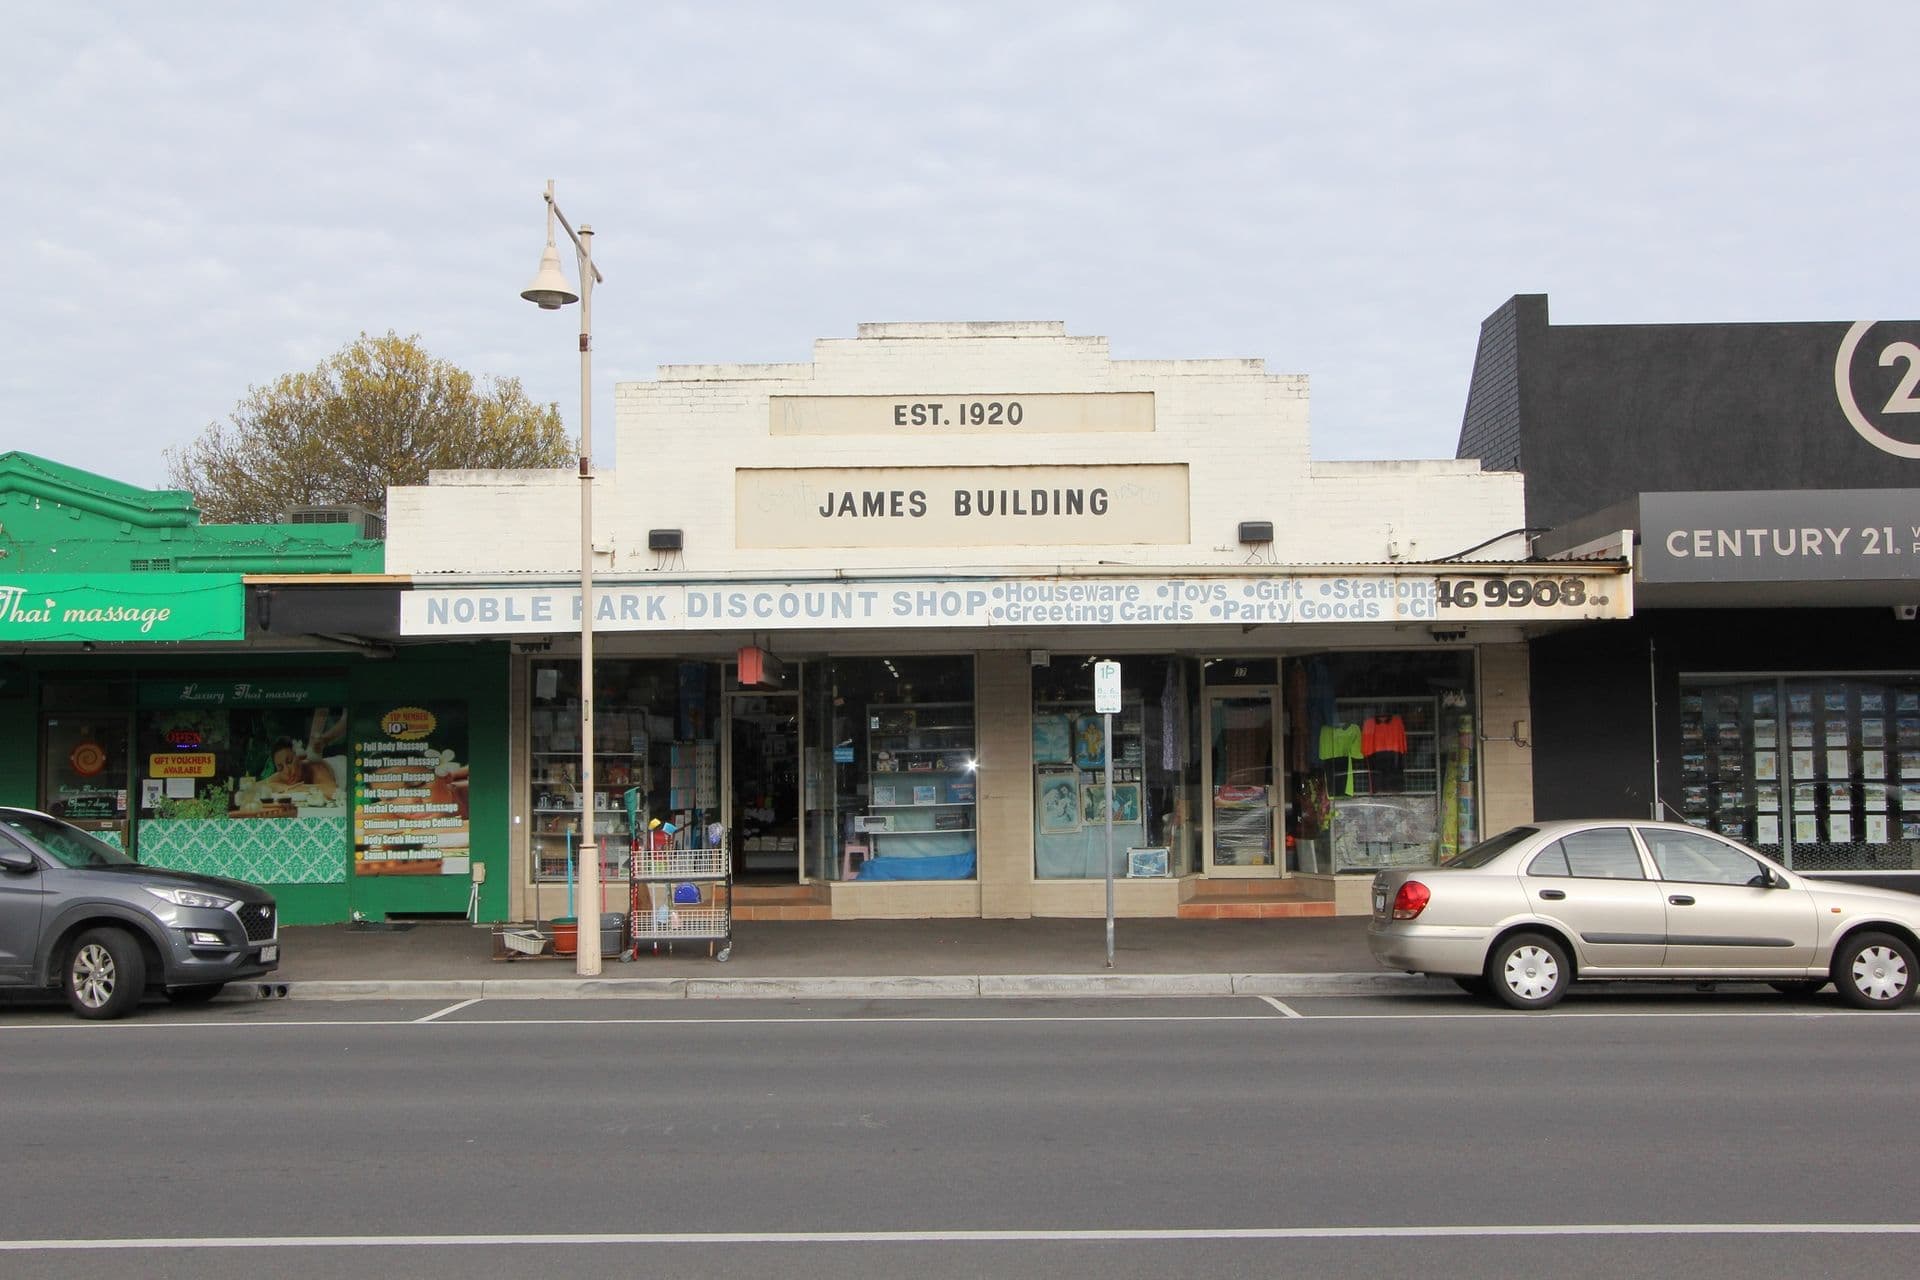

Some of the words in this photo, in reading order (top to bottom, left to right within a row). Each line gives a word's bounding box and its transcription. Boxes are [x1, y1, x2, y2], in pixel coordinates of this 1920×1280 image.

[894, 403, 950, 426] EST.
[959, 402, 1023, 426] 1920
[819, 490, 927, 518] JAMES
[954, 488, 1108, 517] BUILDING
[1666, 527, 1851, 558] CENTURY
[1005, 582, 1140, 602] Houseware
[1167, 580, 1228, 604] Toys
[1256, 580, 1303, 601] Gift
[427, 596, 553, 625] NOBLE
[687, 591, 878, 618] DISCOUNT
[892, 590, 987, 616] SHOP
[1005, 601, 1114, 624] Greeting
[1119, 601, 1194, 622] Cards
[1223, 599, 1292, 623] Party
[1299, 599, 1380, 620] Goods
[63, 605, 171, 633] massage
[179, 682, 225, 703] Luxury
[231, 683, 263, 700] Thai
[265, 690, 309, 703] massage
[363, 742, 377, 751] Full
[378, 742, 396, 752] Body
[396, 741, 429, 751] Massage
[154, 756, 170, 765] GIFT
[171, 756, 212, 765] VOUCHERS
[363, 758, 383, 767] Deep
[383, 758, 407, 767] Tissue
[408, 756, 440, 767] Massage
[163, 766, 202, 775] AVAILABLE
[363, 773, 402, 783] Relaxation
[402, 772, 435, 783] Massage
[364, 789, 376, 798] Hot
[377, 788, 398, 798] Stone
[399, 788, 431, 798] Massage
[364, 804, 388, 813] Herbal
[388, 803, 425, 814] Compress
[425, 803, 458, 814] Massage
[364, 819, 398, 829] Slimming
[399, 818, 431, 829] Massage
[364, 835, 382, 845] Body
[405, 834, 438, 845] Massage
[364, 851, 387, 860] Sauna
[387, 850, 409, 859] Room
[409, 849, 442, 859] Available
